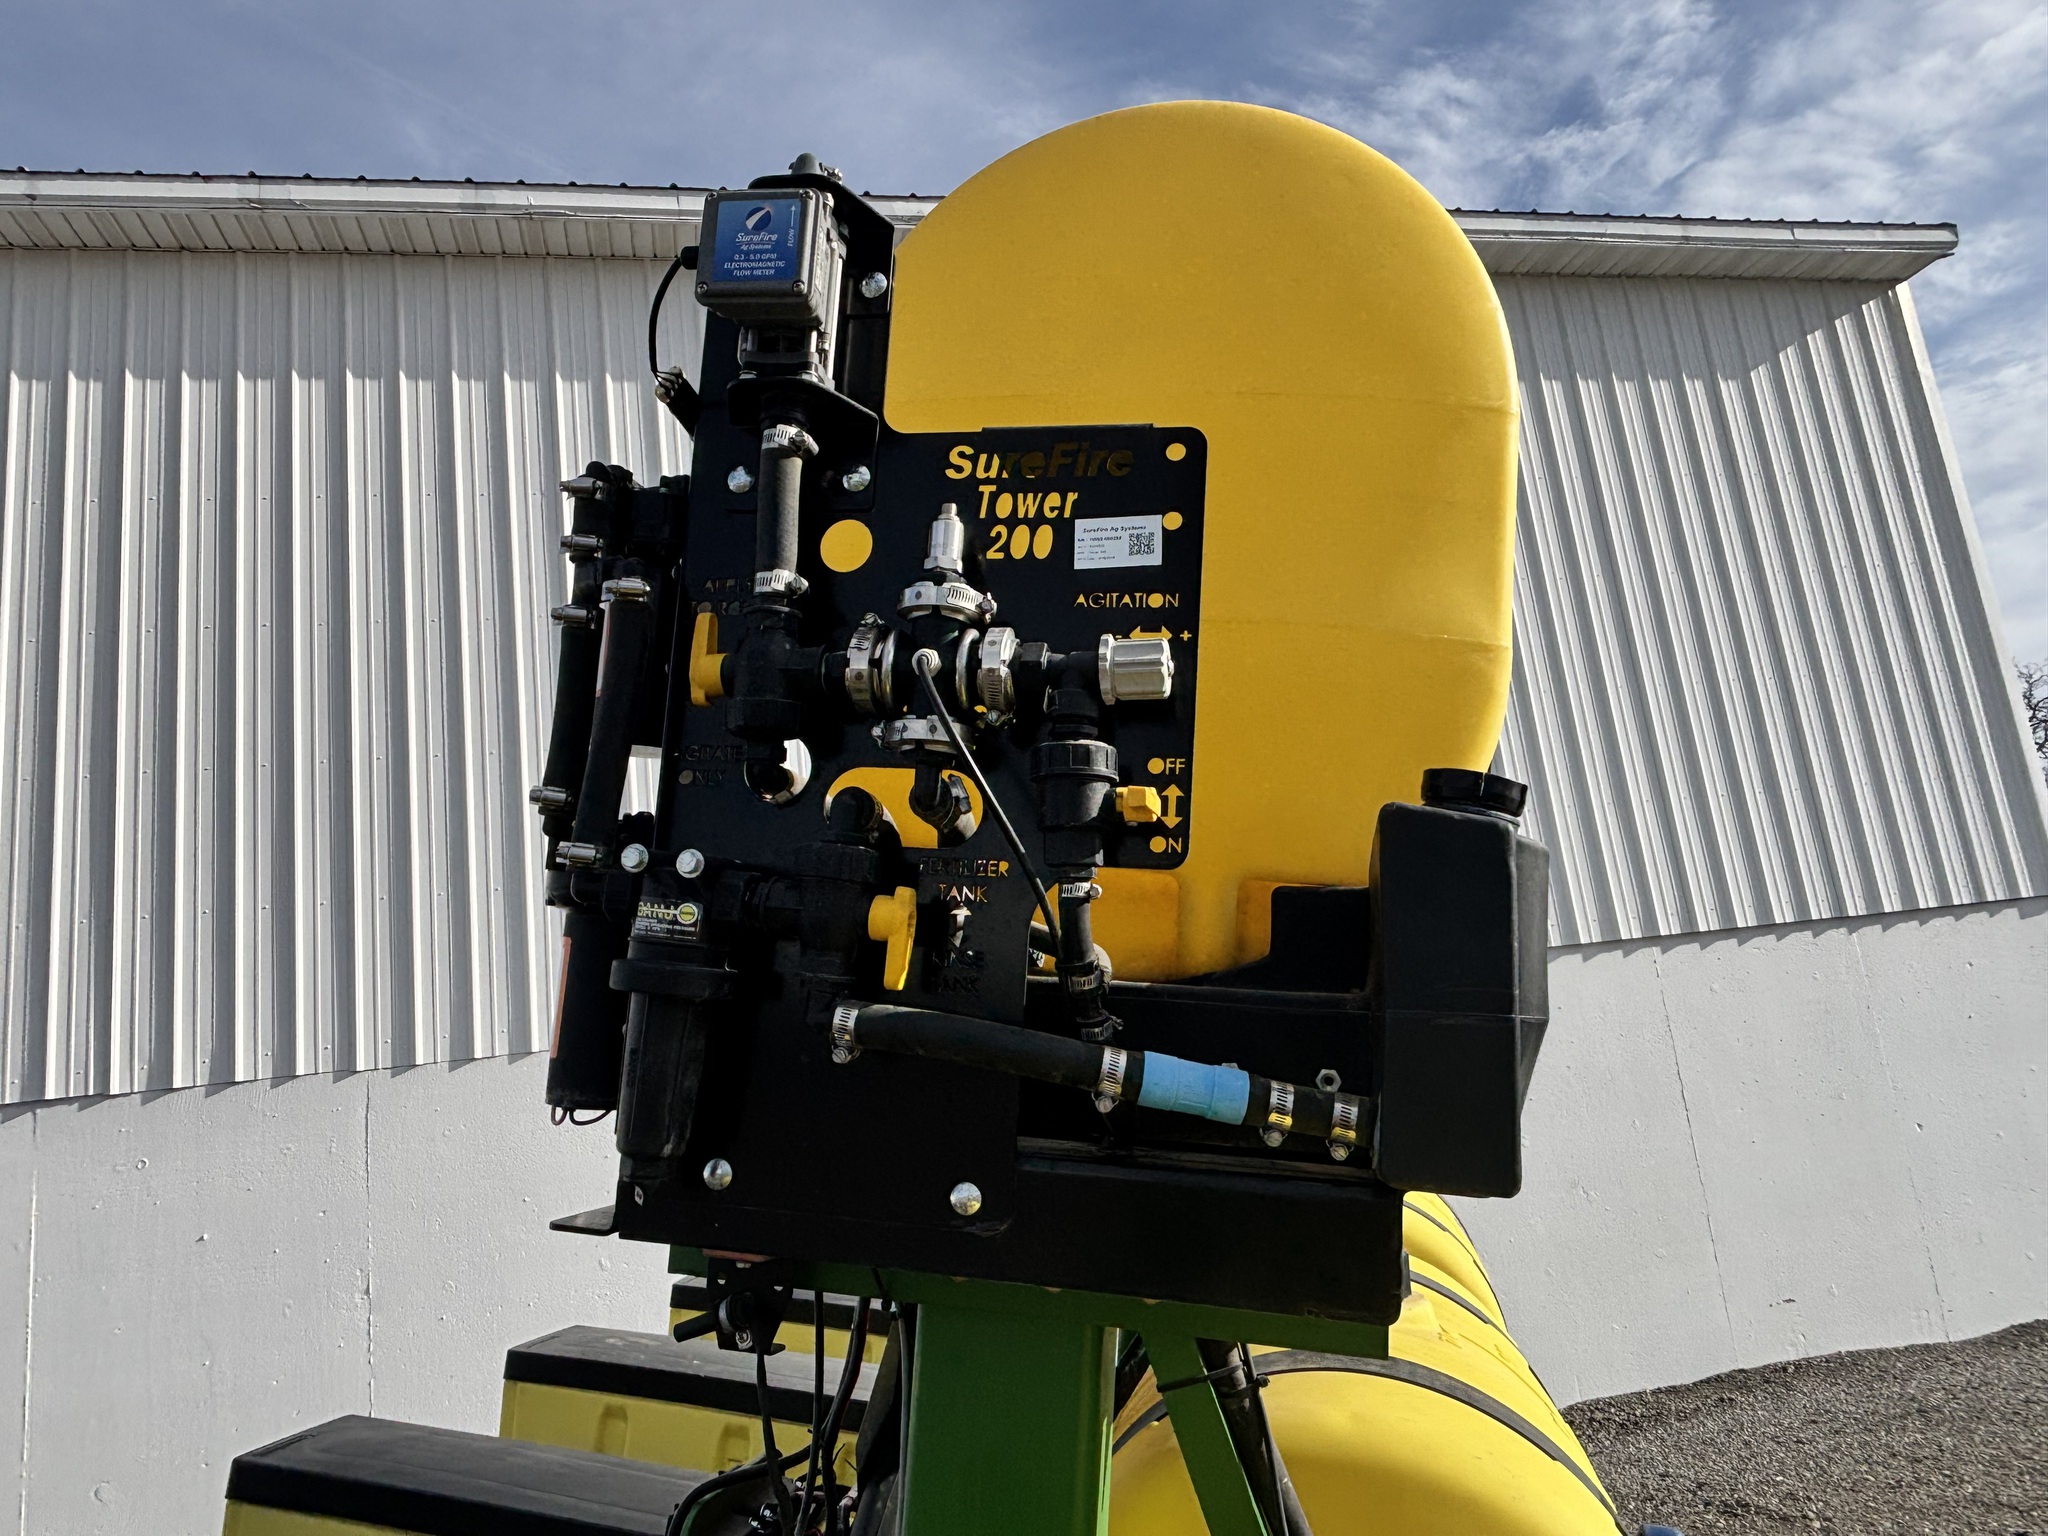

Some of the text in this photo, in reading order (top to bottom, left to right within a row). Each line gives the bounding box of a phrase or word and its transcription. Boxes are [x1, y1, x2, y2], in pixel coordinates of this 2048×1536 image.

[736, 231, 778, 242] SureFire
[787, 229, 795, 247] FLOW
[724, 260, 786, 269] ELECTROMAGNETIC
[945, 442, 1135, 480] SureFire
[978, 484, 1079, 519] Tower
[986, 524, 1054, 560] 200
[1073, 592, 1179, 608] AGITATION
[1147, 757, 1186, 775] OFF
[1149, 836, 1182, 854] ON
[939, 884, 988, 903] TANK
